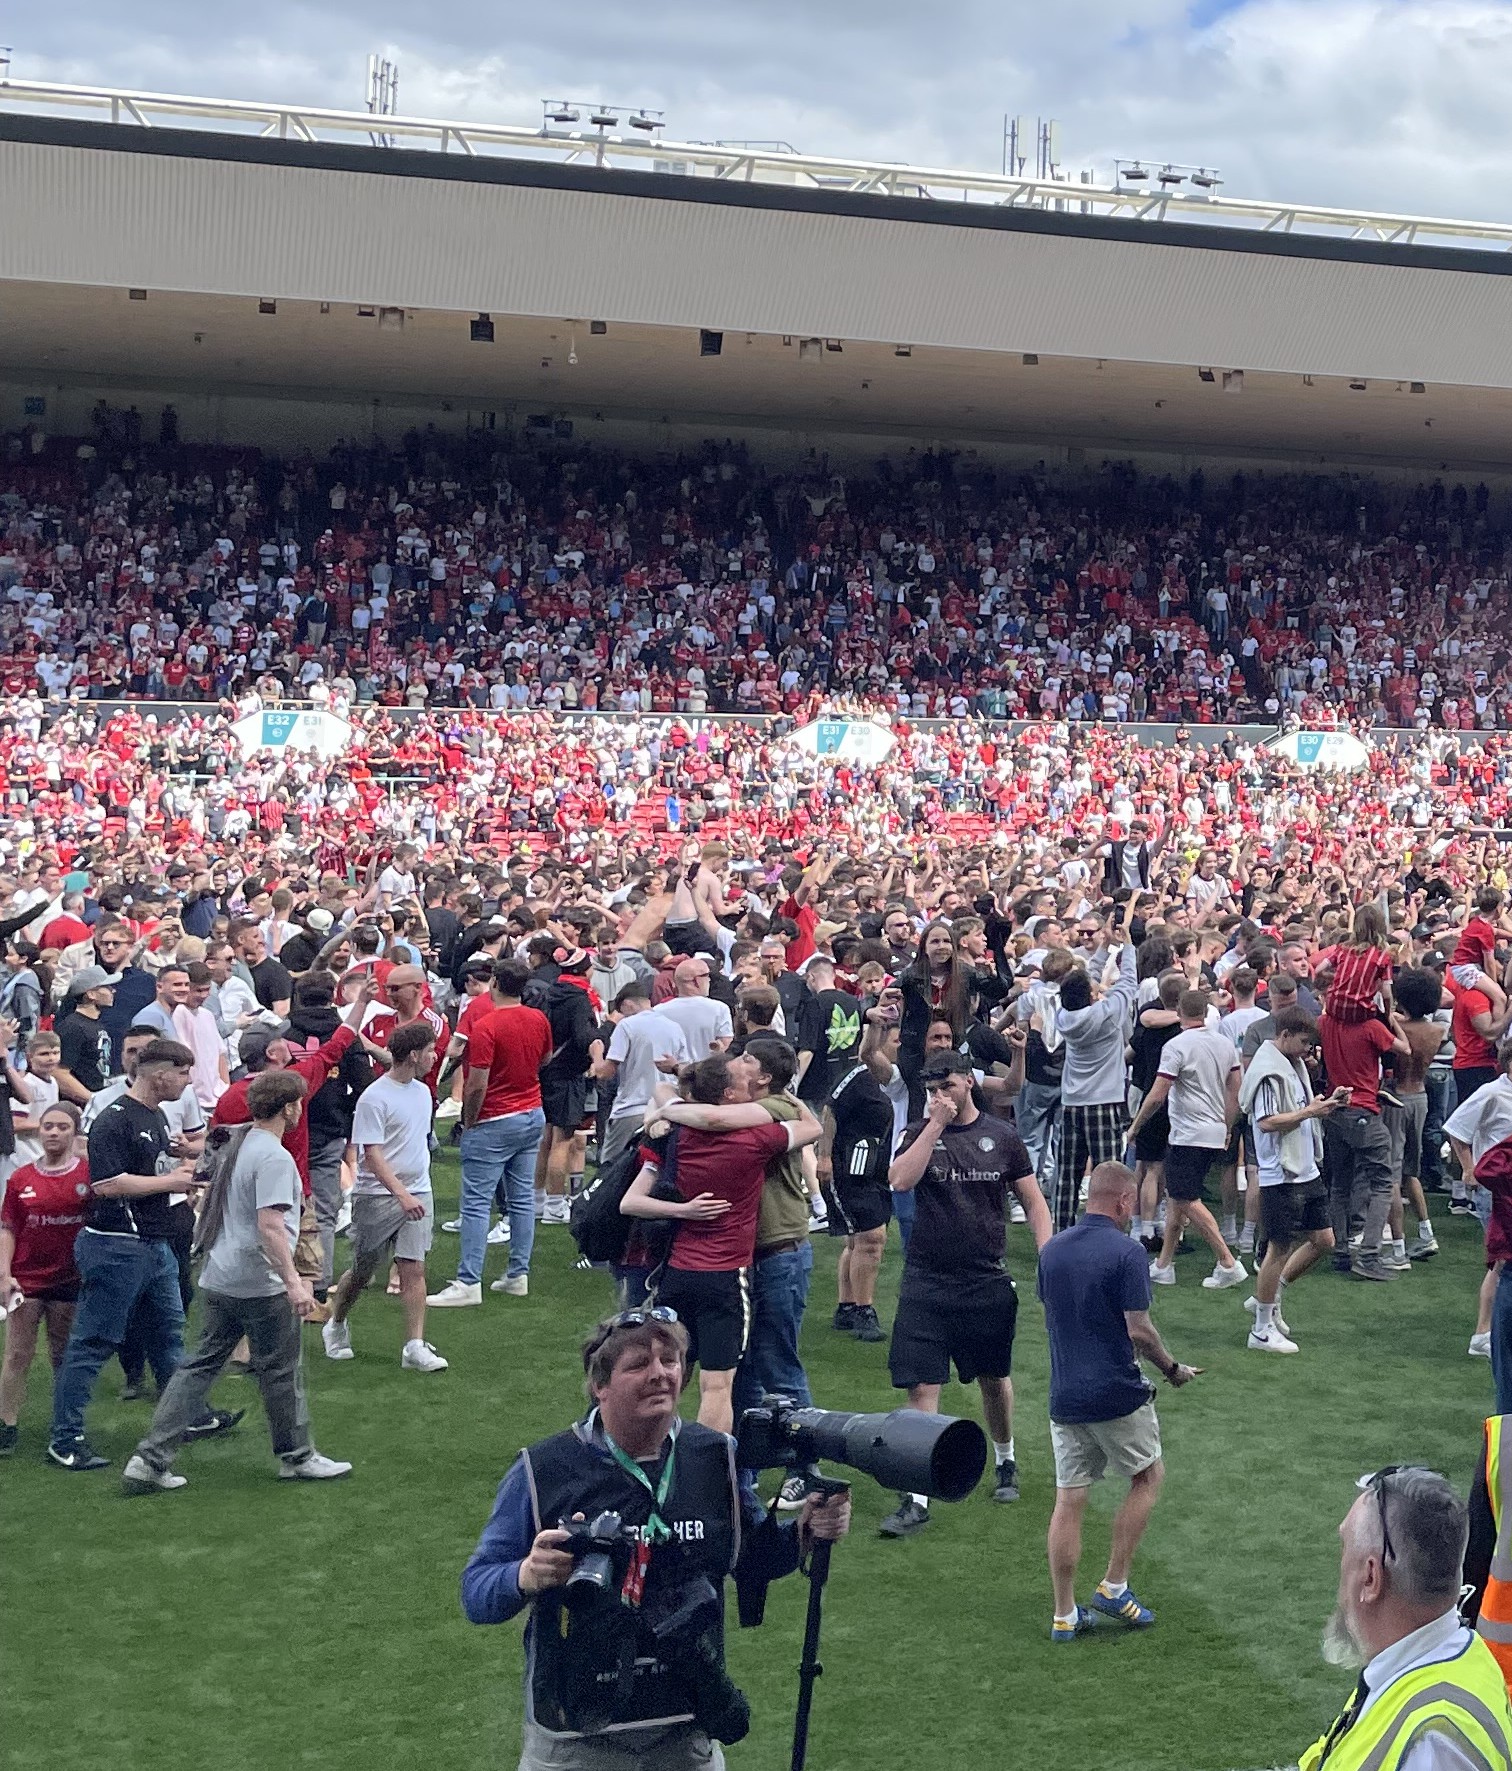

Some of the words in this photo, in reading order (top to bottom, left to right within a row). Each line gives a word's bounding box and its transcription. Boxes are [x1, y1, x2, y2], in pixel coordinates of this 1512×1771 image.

[267, 715, 289, 725] E32
[304, 716, 321, 725] E31
[822, 725, 840, 736] E31
[1301, 735, 1318, 744] E30
